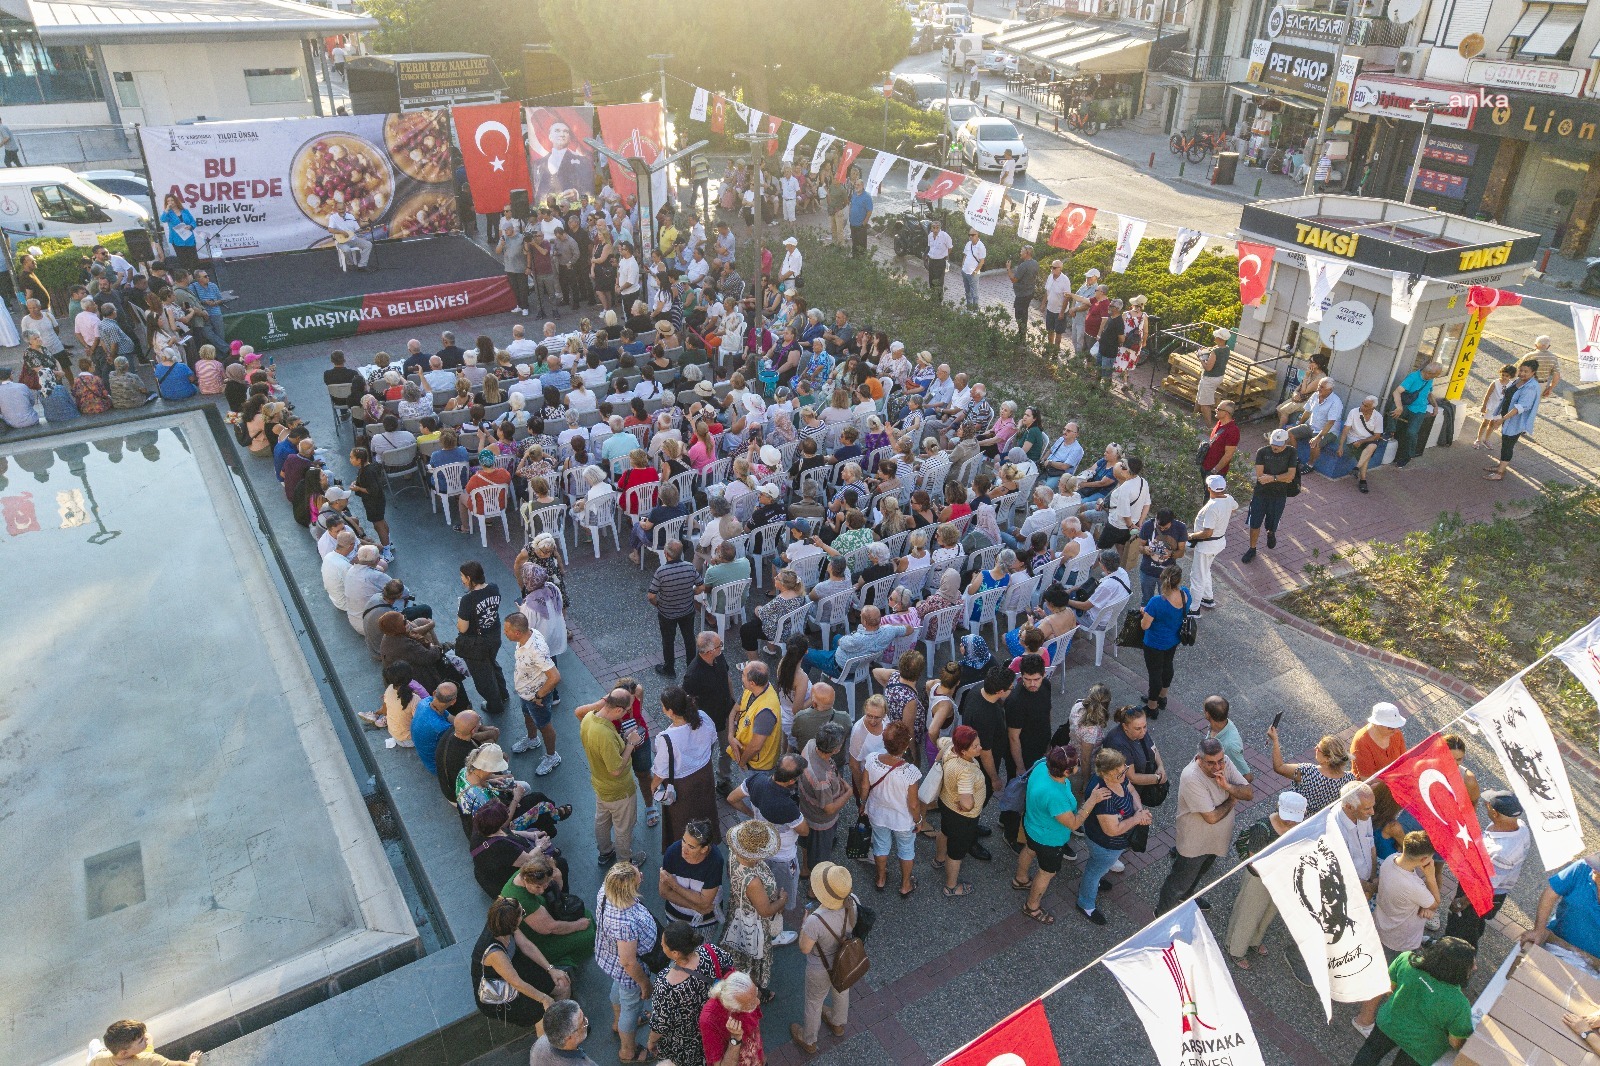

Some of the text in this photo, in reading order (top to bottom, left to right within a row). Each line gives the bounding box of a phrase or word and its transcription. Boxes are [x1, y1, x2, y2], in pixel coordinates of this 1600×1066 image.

[429, 61, 448, 72] EFE
[1268, 52, 1329, 82] PET SHOP
[1497, 65, 1559, 84] SINGER
[217, 131, 259, 140] YILDIZ ÜNSAL
[1523, 106, 1597, 140] Lion
[204, 157, 236, 178] BU
[169, 178, 283, 209] AŞURE'DE
[196, 212, 267, 227] Bereket Var!
[202, 203, 255, 215] Birlik Var,
[1295, 222, 1359, 258] TAKSİ
[1458, 240, 1514, 271] TAKSİ
[291, 290, 469, 330] KARŞIYAKA BELEDİYESİ
[1182, 1032, 1246, 1057] ARŞIYAKA
